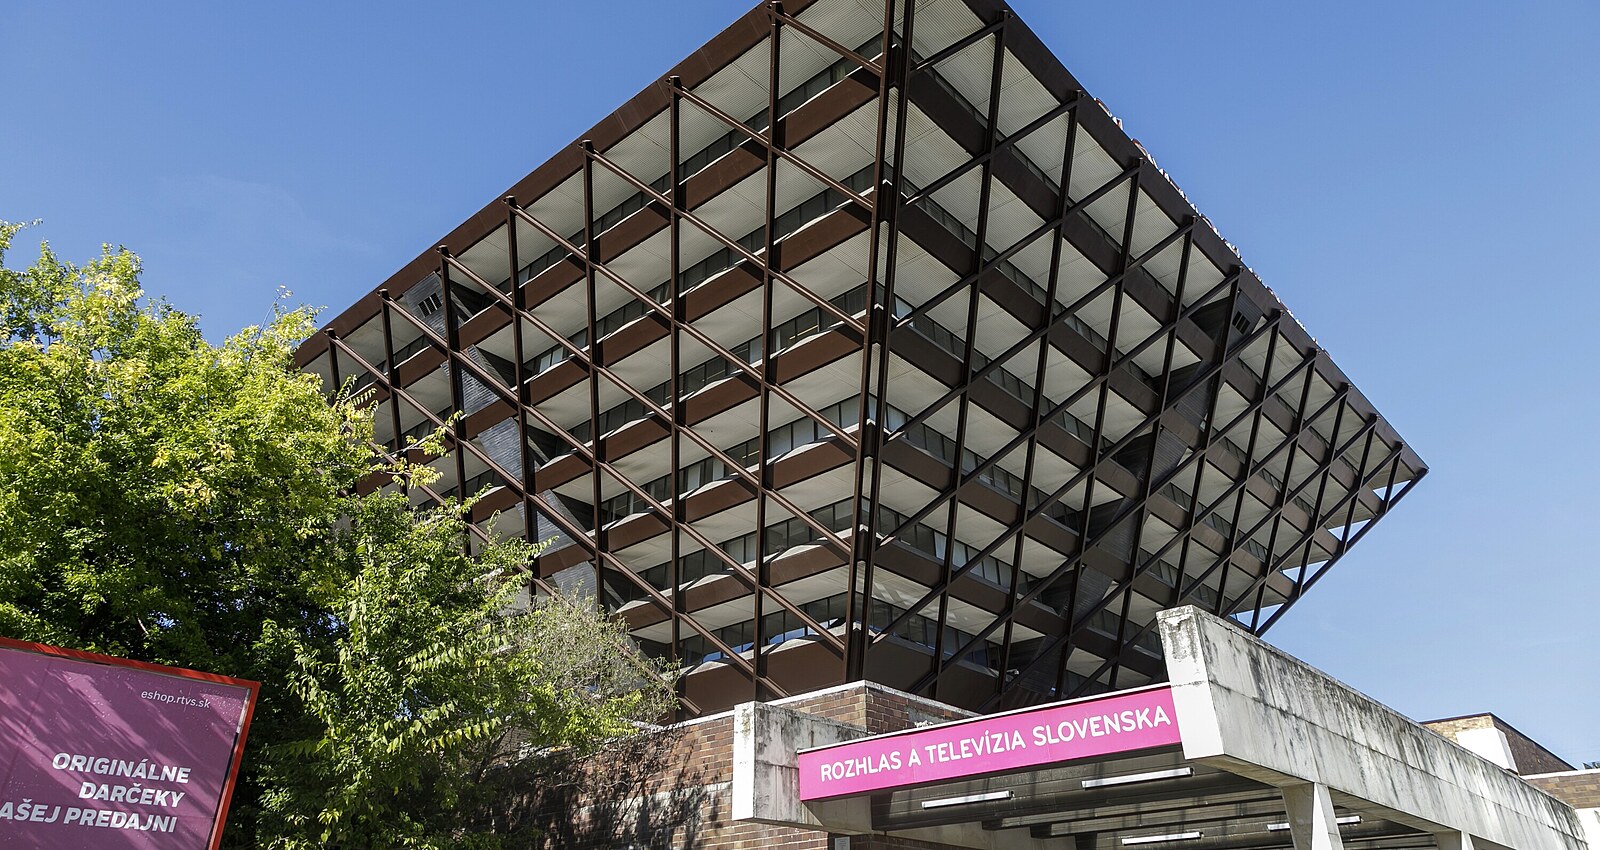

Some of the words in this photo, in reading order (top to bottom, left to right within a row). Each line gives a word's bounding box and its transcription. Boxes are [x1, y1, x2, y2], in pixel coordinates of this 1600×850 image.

[140, 689, 211, 709] eshop.rtvs.sk
[819, 751, 901, 782] ROZHLAS
[908, 749, 921, 768] A
[924, 730, 1026, 763] TELEVÍZIA
[1033, 705, 1171, 747] SLOVENSKA
[52, 752, 191, 783] ORIGINÁLNE
[78, 782, 185, 808] DARČEKY
[0, 798, 61, 823] AŠEJ
[63, 807, 177, 833] PREDAJNI
